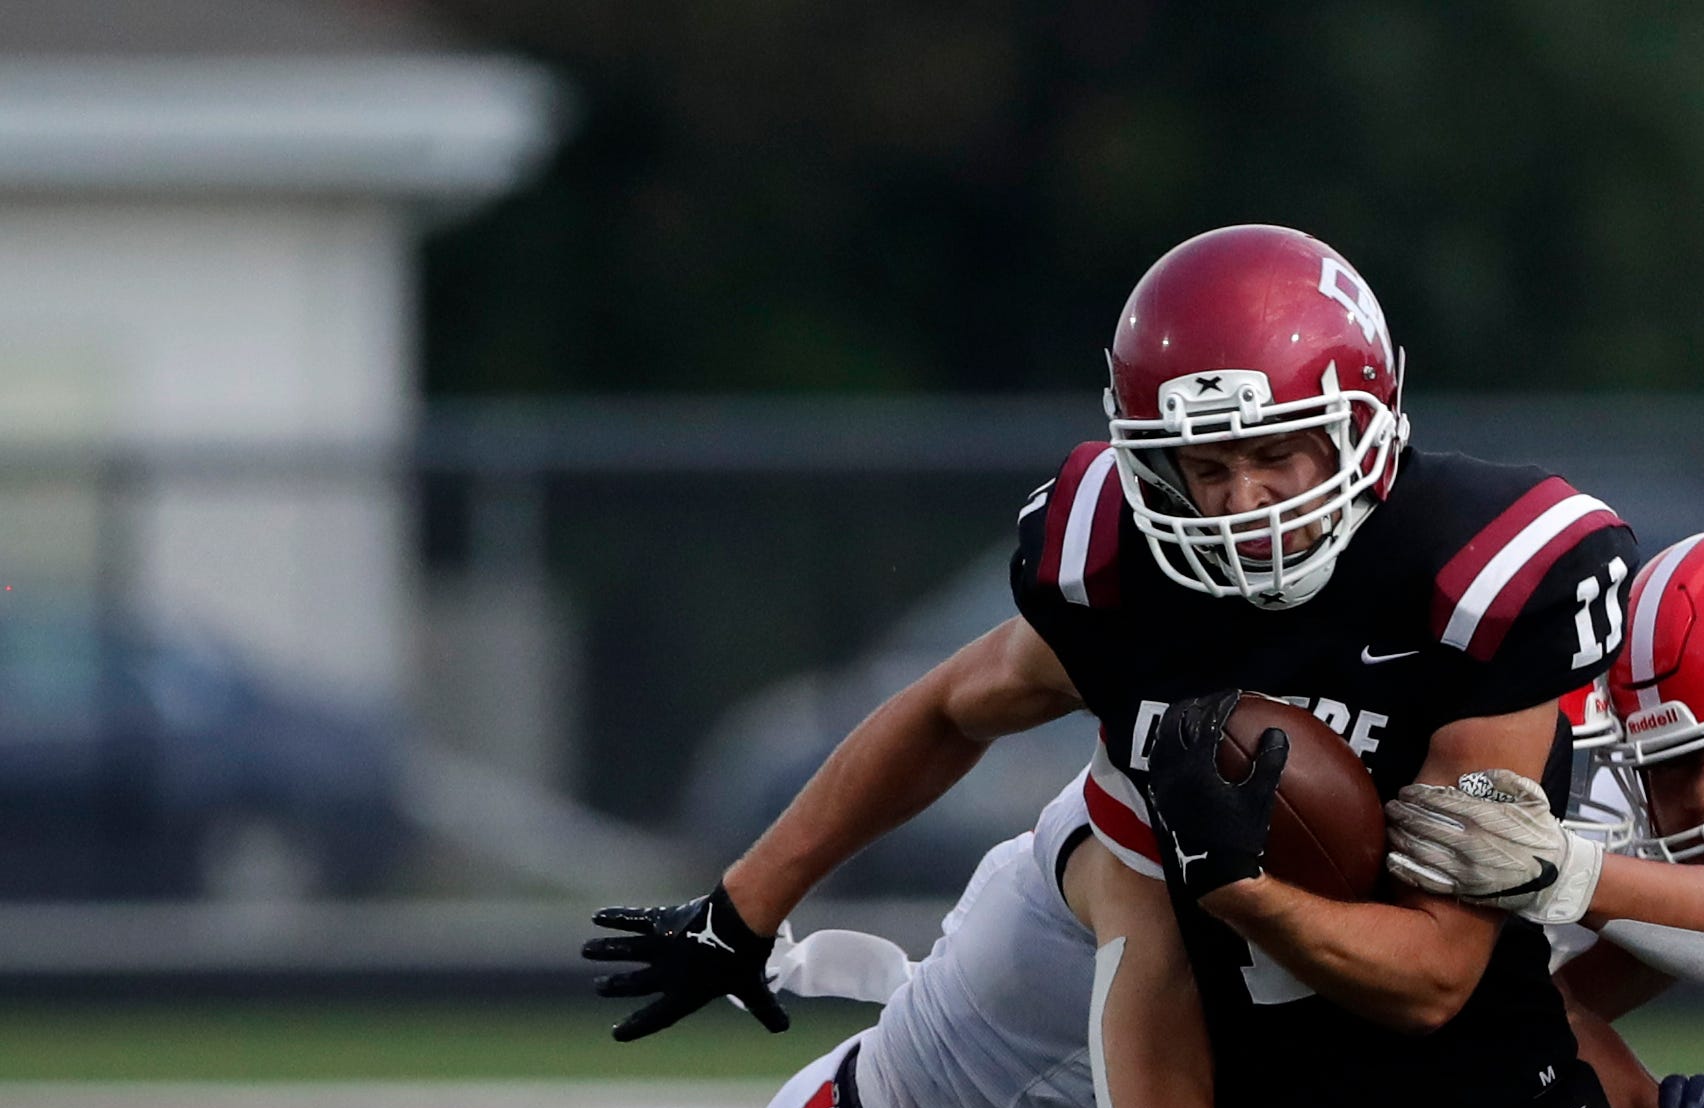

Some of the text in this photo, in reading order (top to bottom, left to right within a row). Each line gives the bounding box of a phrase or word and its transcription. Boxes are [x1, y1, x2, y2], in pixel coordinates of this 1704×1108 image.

[1571, 555, 1628, 670] 11
[1627, 707, 1679, 735] Riddell
[1539, 1065, 1556, 1087] M
